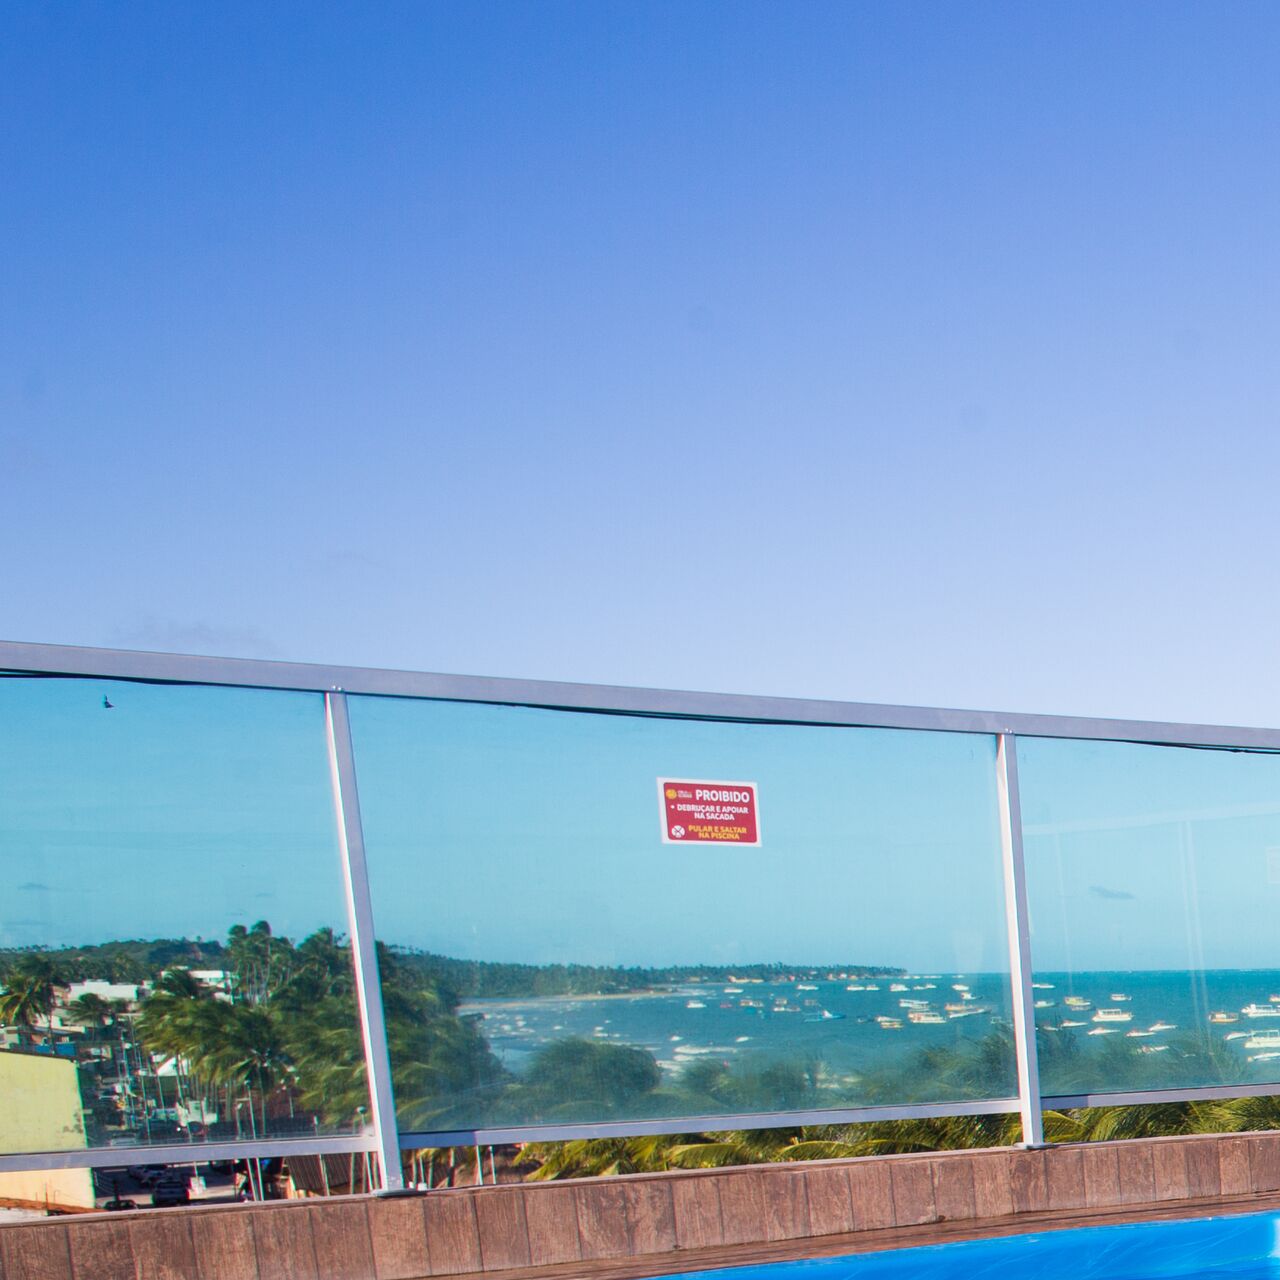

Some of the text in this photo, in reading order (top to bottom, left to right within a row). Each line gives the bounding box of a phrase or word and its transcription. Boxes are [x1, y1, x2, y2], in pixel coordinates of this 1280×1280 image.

[695, 790, 750, 803] PROIBIDO
[722, 806, 748, 814] APOIAR
[688, 825, 712, 833] PULAR
